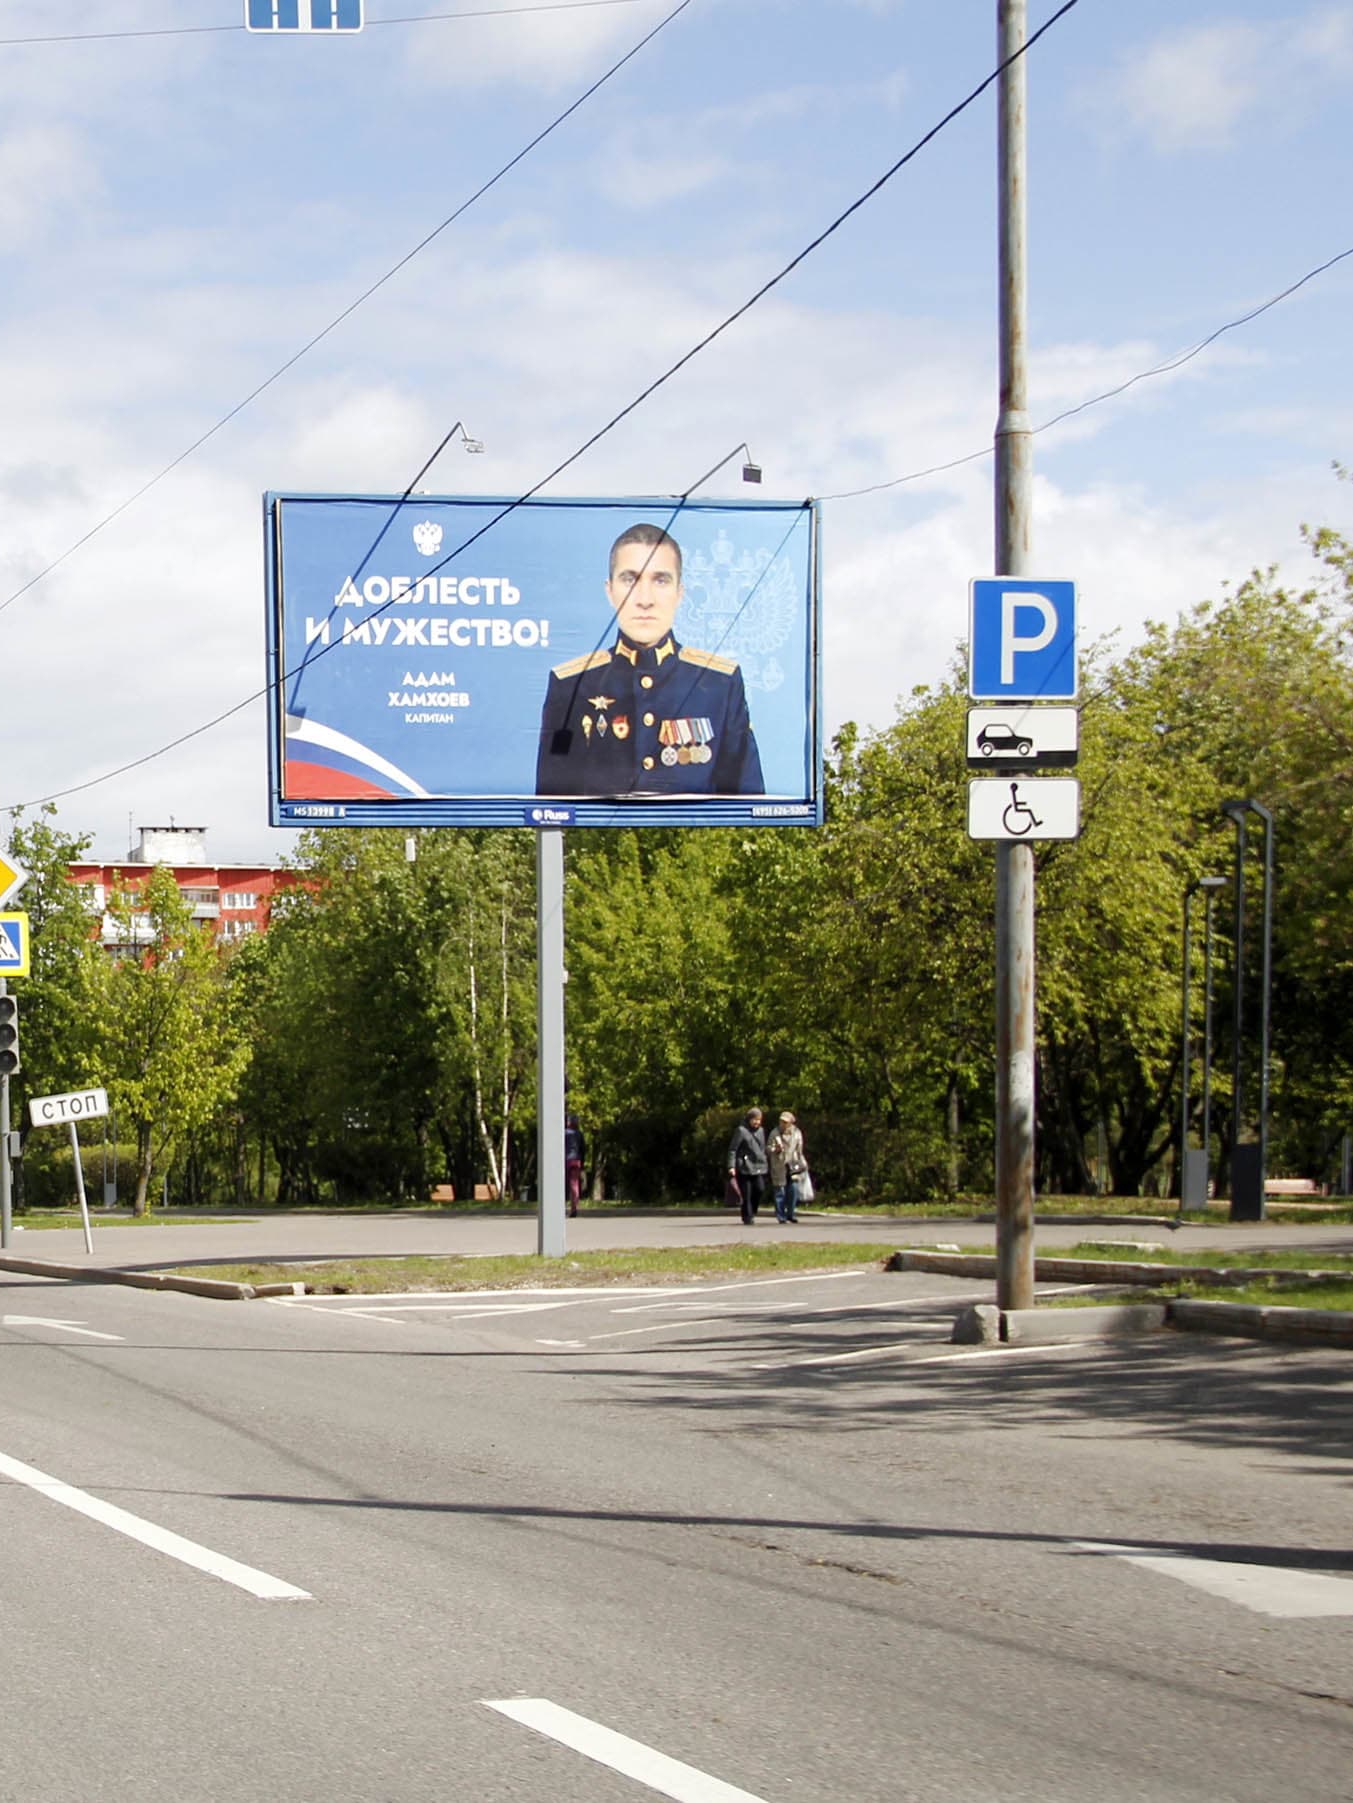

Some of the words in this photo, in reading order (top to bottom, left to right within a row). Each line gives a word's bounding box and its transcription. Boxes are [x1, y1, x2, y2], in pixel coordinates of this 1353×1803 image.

[334, 575, 521, 607] ДОБЛЕСТЬ
[305, 617, 330, 645] И
[342, 617, 550, 647] МУЖЕСТВО!
[1000, 592, 1058, 685] P
[402, 671, 456, 688] АДАМ
[388, 692, 470, 707] ХАМХОЕВ
[405, 713, 454, 723] КАПИТАН
[543, 809, 570, 820] Russ
[42, 1095, 98, 1119] СТОП
